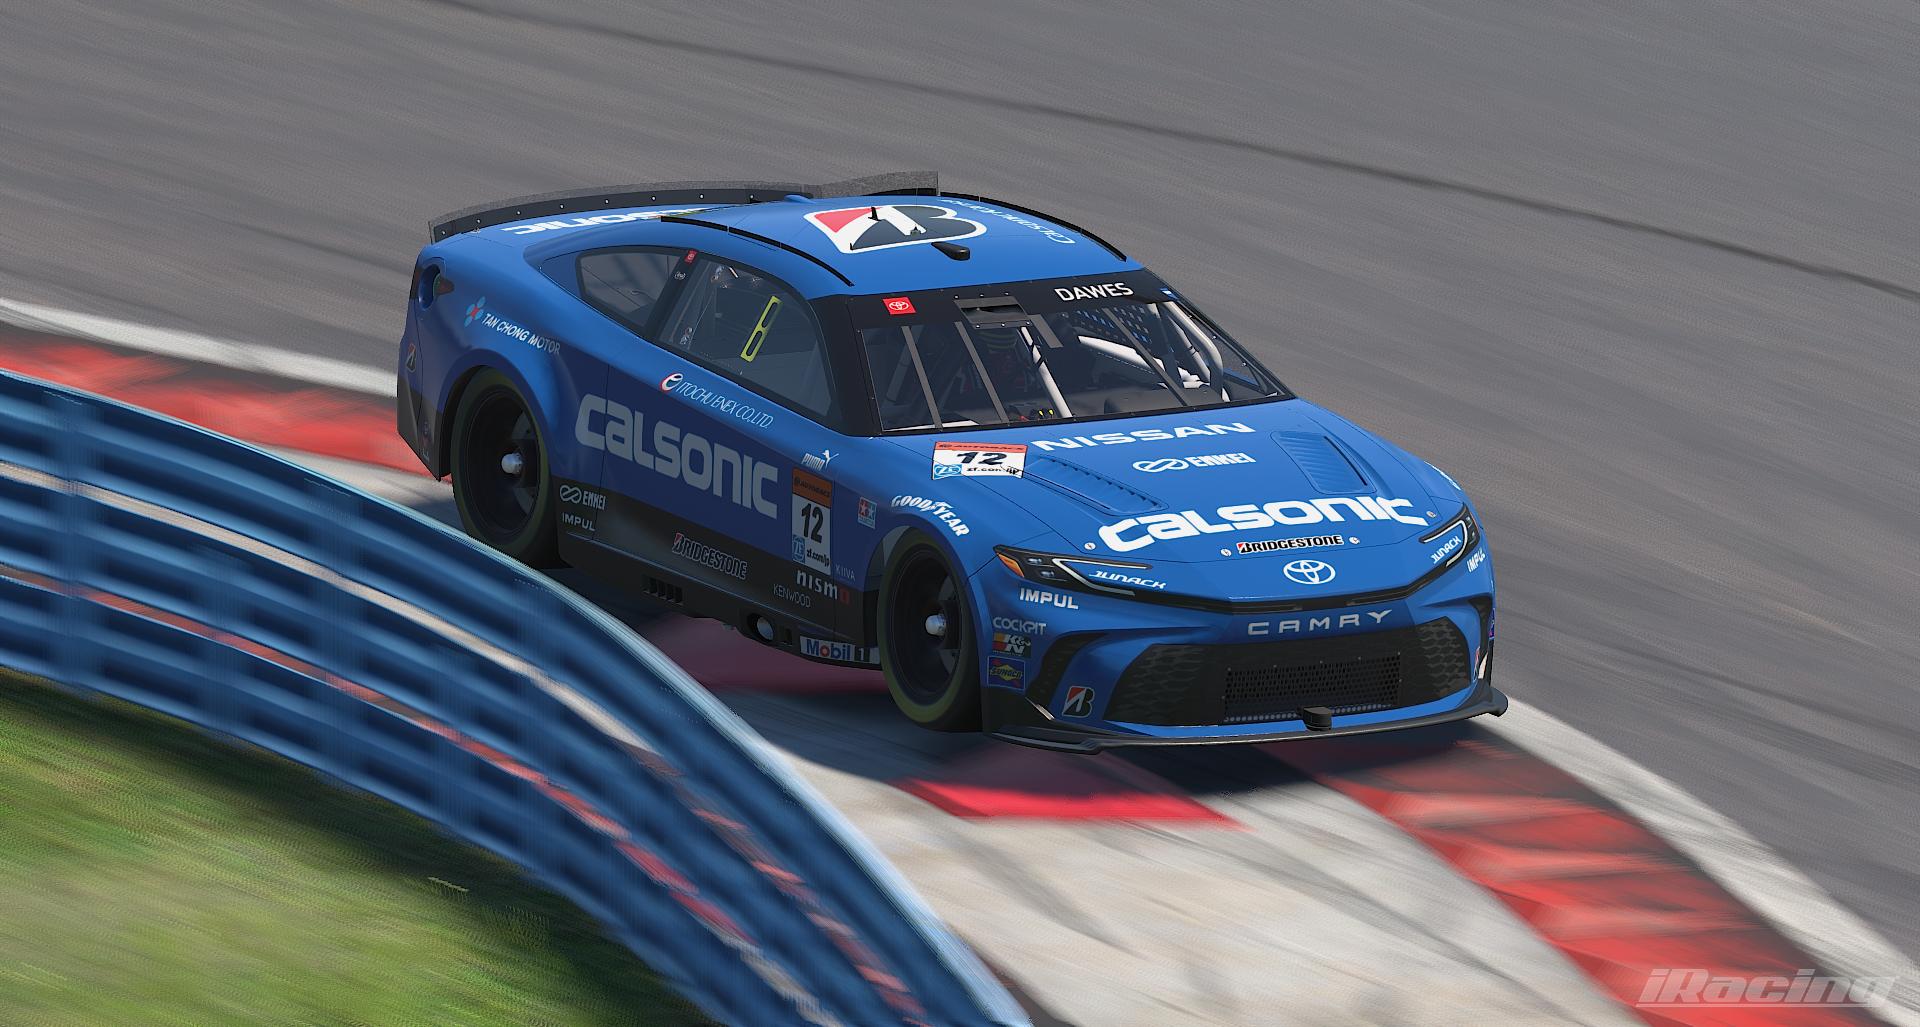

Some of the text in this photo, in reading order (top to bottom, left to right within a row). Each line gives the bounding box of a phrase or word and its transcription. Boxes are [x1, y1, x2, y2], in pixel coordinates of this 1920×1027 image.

[1054, 282, 1134, 301] DAWES
[481, 312, 561, 355] TAN CHONG MOTOR
[675, 381, 715, 406] ITOCHU
[711, 396, 739, 415] ENEX
[1032, 422, 1256, 451] NISSAN
[957, 451, 1007, 466] 12
[1188, 452, 1257, 469] ENKEI
[582, 489, 607, 511] ENKEI
[562, 511, 596, 533] IMPUL
[801, 503, 823, 544] 12
[672, 532, 748, 580] BRIDGESTONE
[1236, 534, 1344, 556] BRIDGESTONE
[1431, 535, 1461, 565] JUNACK
[1088, 570, 1167, 589] JUNACK
[773, 583, 811, 608] KENWOOD
[1019, 587, 1079, 610] IMPUL
[992, 616, 1047, 636] COCKPIT
[1247, 608, 1393, 637] CAMRY
[806, 638, 851, 662] Mobil
